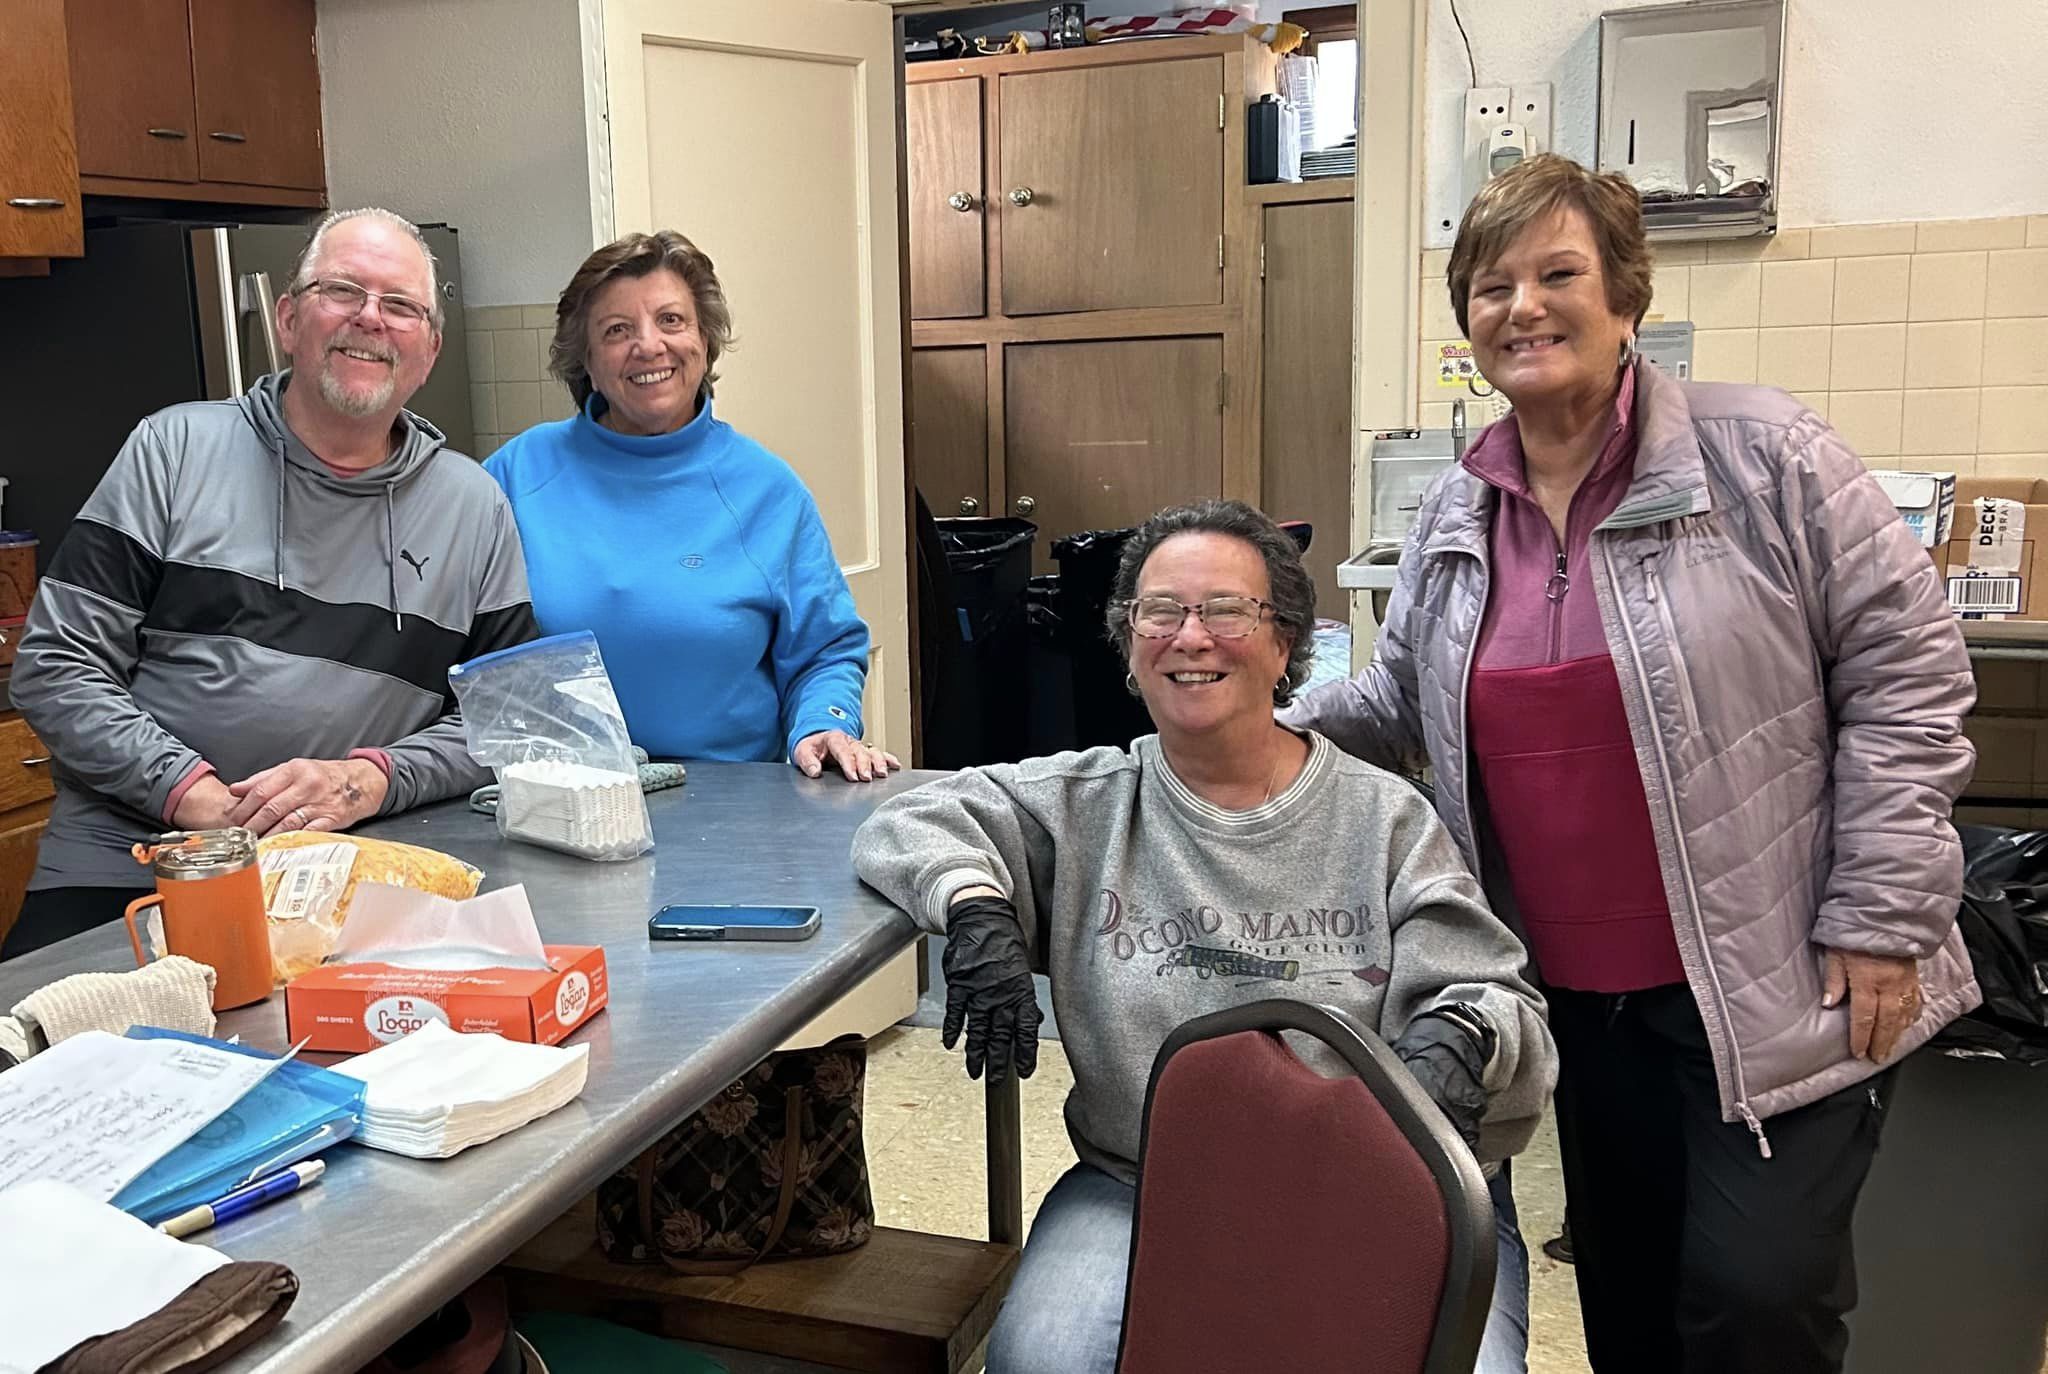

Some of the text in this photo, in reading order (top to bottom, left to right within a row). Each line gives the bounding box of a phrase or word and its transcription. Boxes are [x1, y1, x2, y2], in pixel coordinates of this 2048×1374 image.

[1238, 904, 1375, 942] MANOR
[1230, 939, 1366, 956] GOLF CLUB
[560, 986, 586, 1017] Logan
[377, 1009, 429, 1035] Loga
